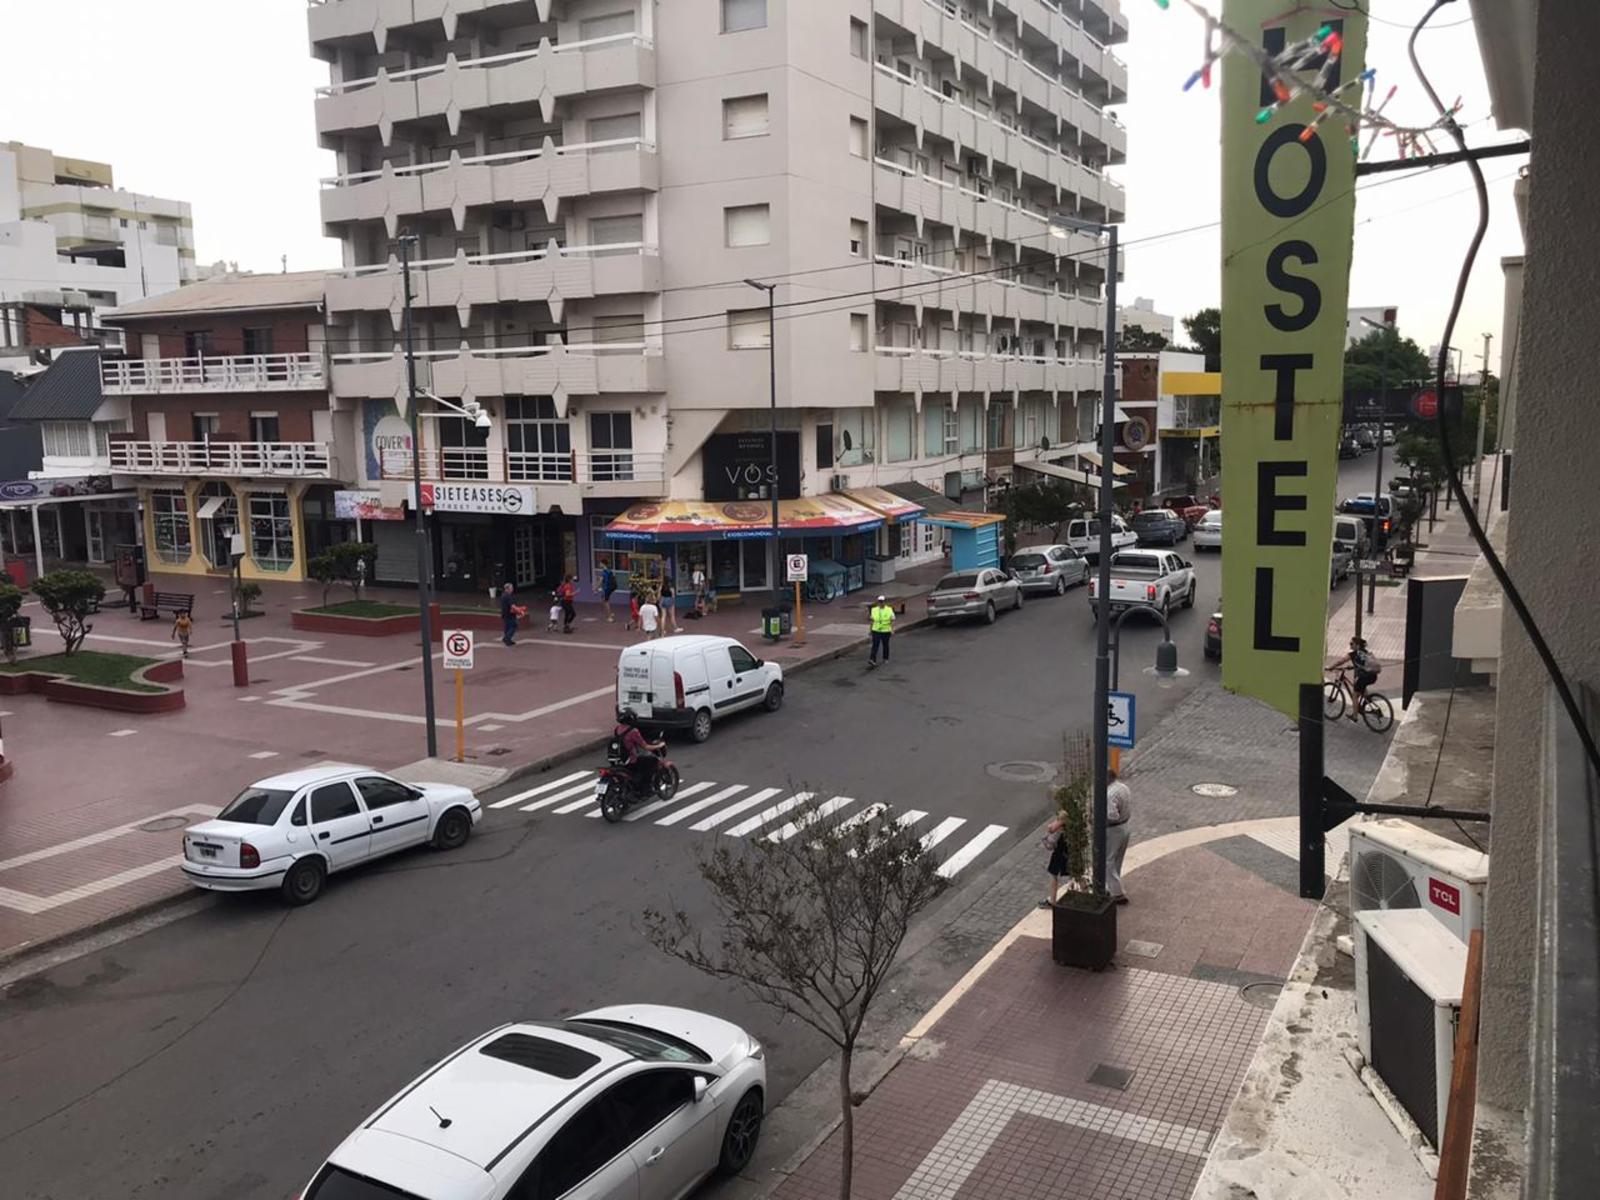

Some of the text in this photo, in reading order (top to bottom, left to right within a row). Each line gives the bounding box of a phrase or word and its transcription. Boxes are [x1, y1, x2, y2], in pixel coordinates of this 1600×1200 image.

[1253, 19, 1344, 652] HOSTEL
[435, 487, 503, 503] SIETEASES
[1432, 887, 1456, 906] TCL
